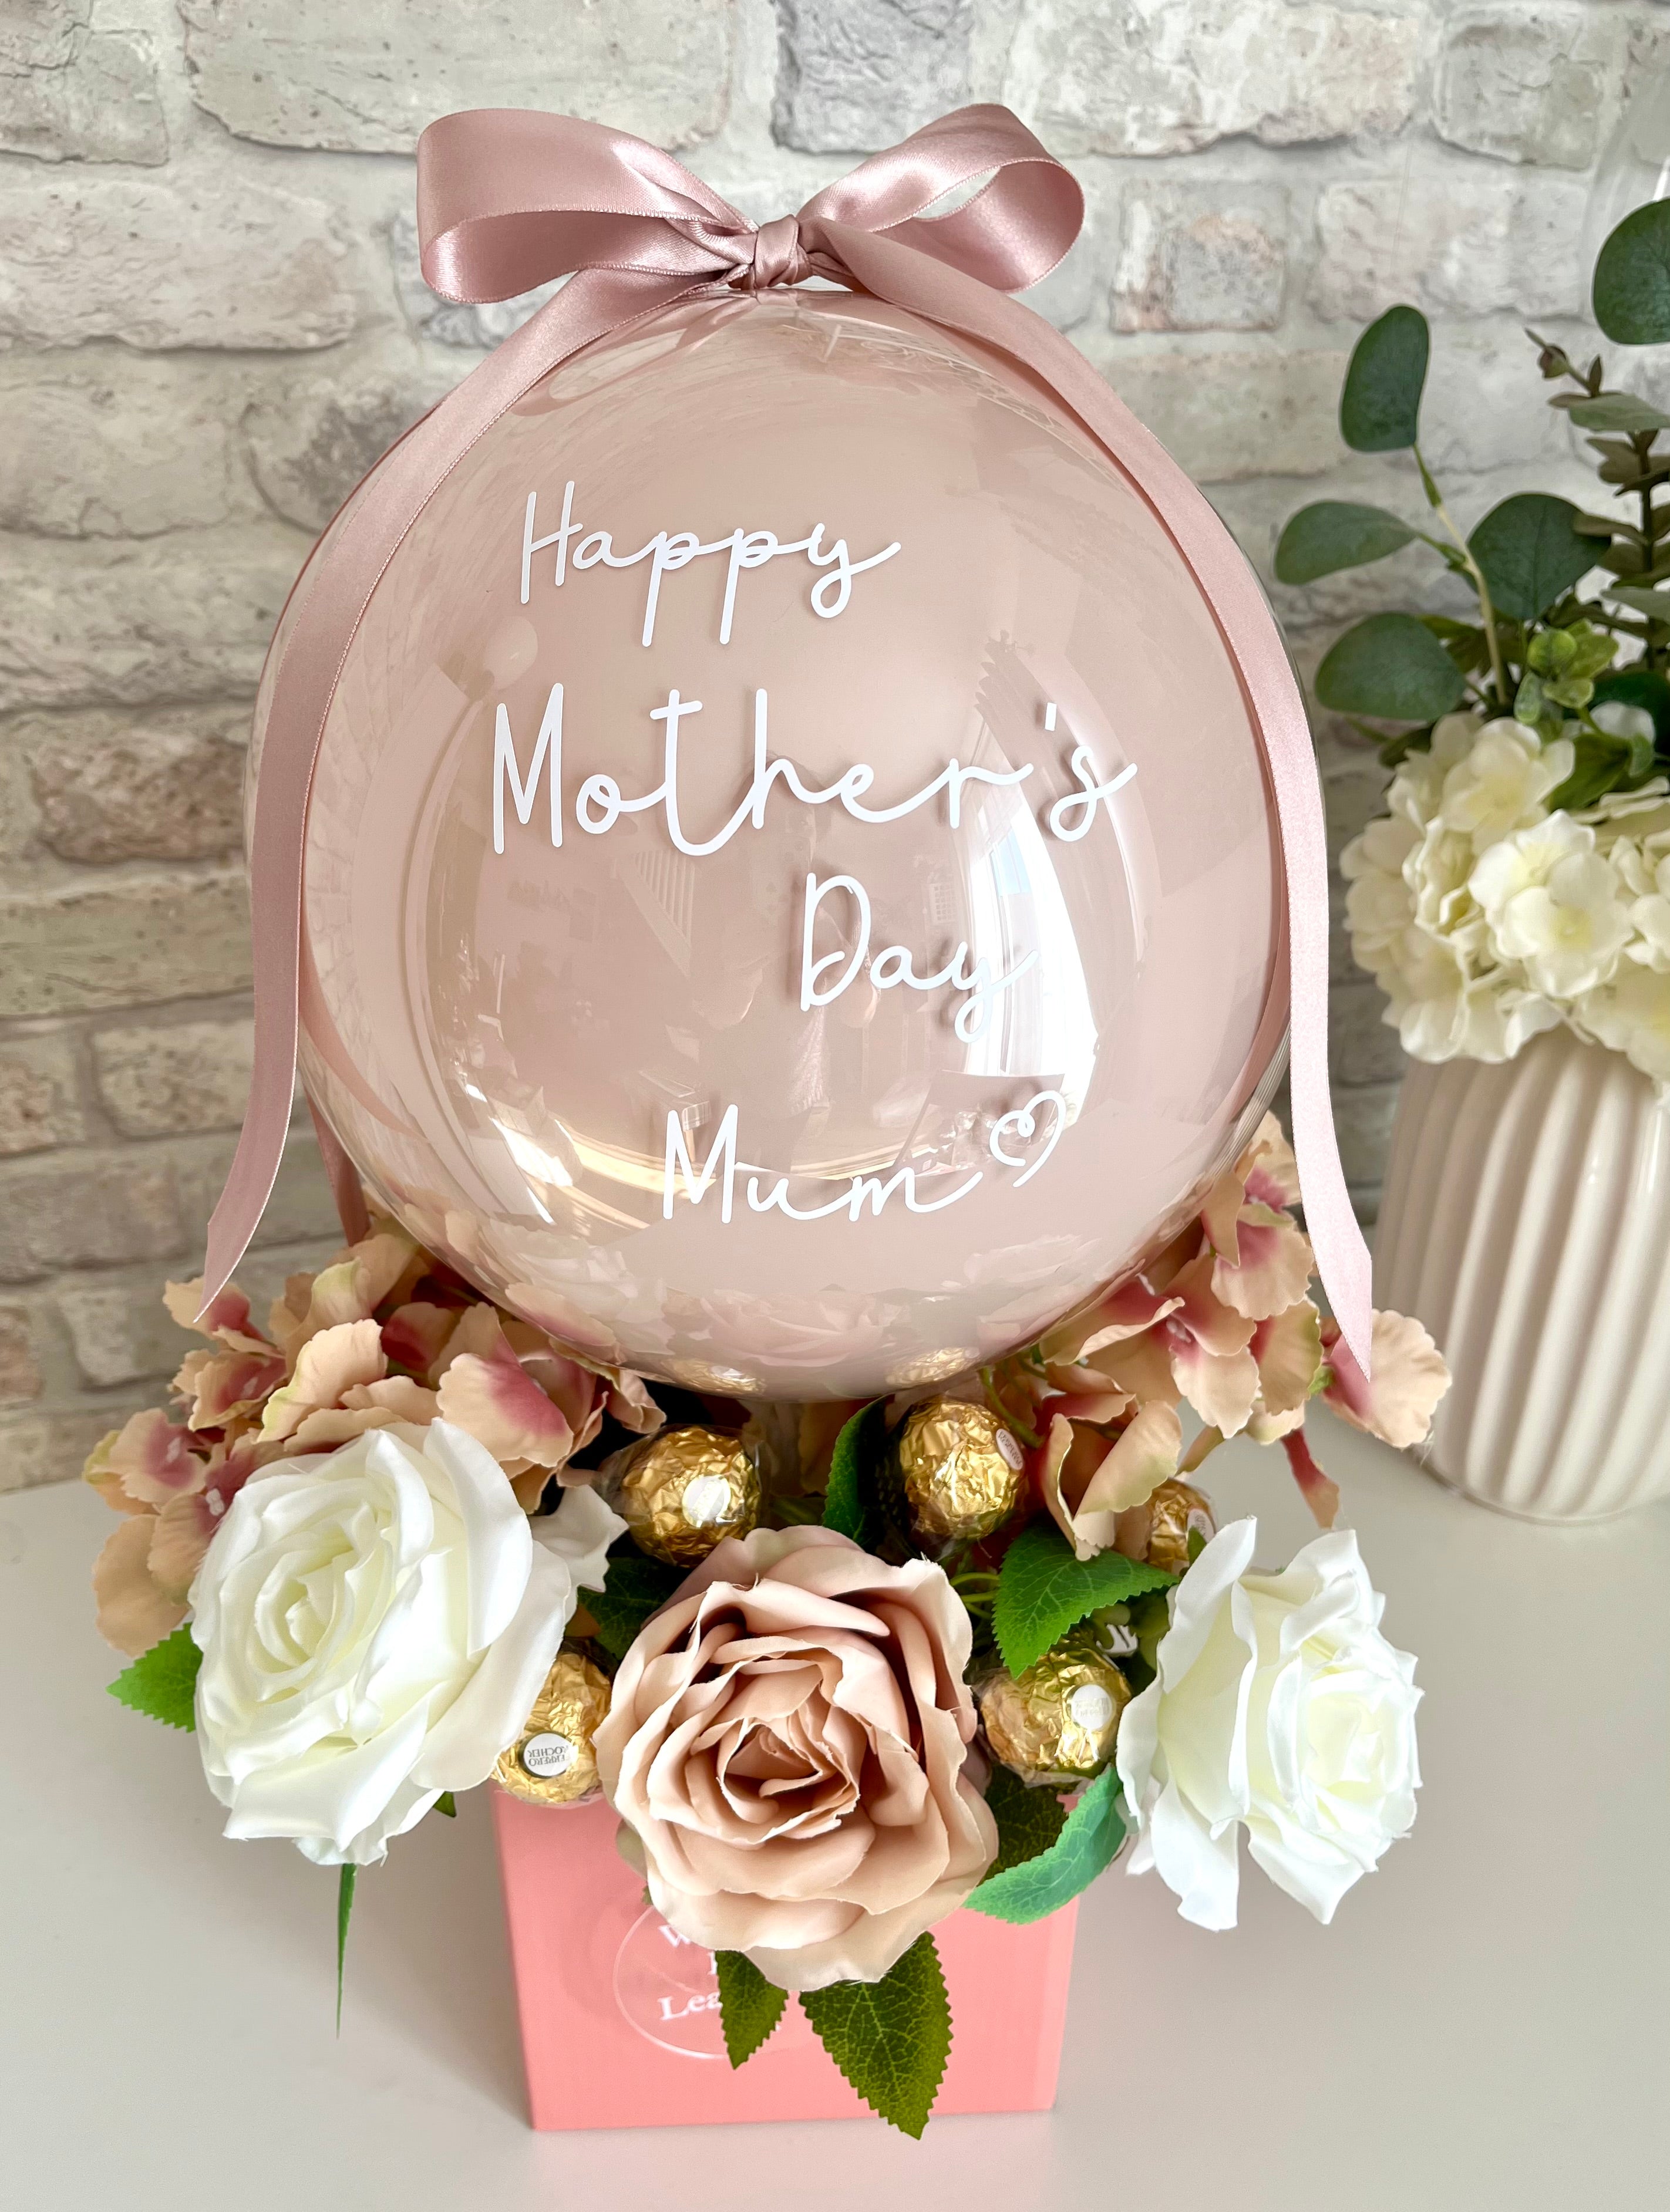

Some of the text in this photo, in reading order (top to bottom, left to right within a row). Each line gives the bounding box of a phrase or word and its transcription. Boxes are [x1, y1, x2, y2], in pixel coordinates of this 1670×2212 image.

[520, 480, 902, 647] Happy
[493, 682, 1139, 857] Mother's
[800, 872, 1039, 1044] Day
[662, 1104, 984, 1224] Mum
